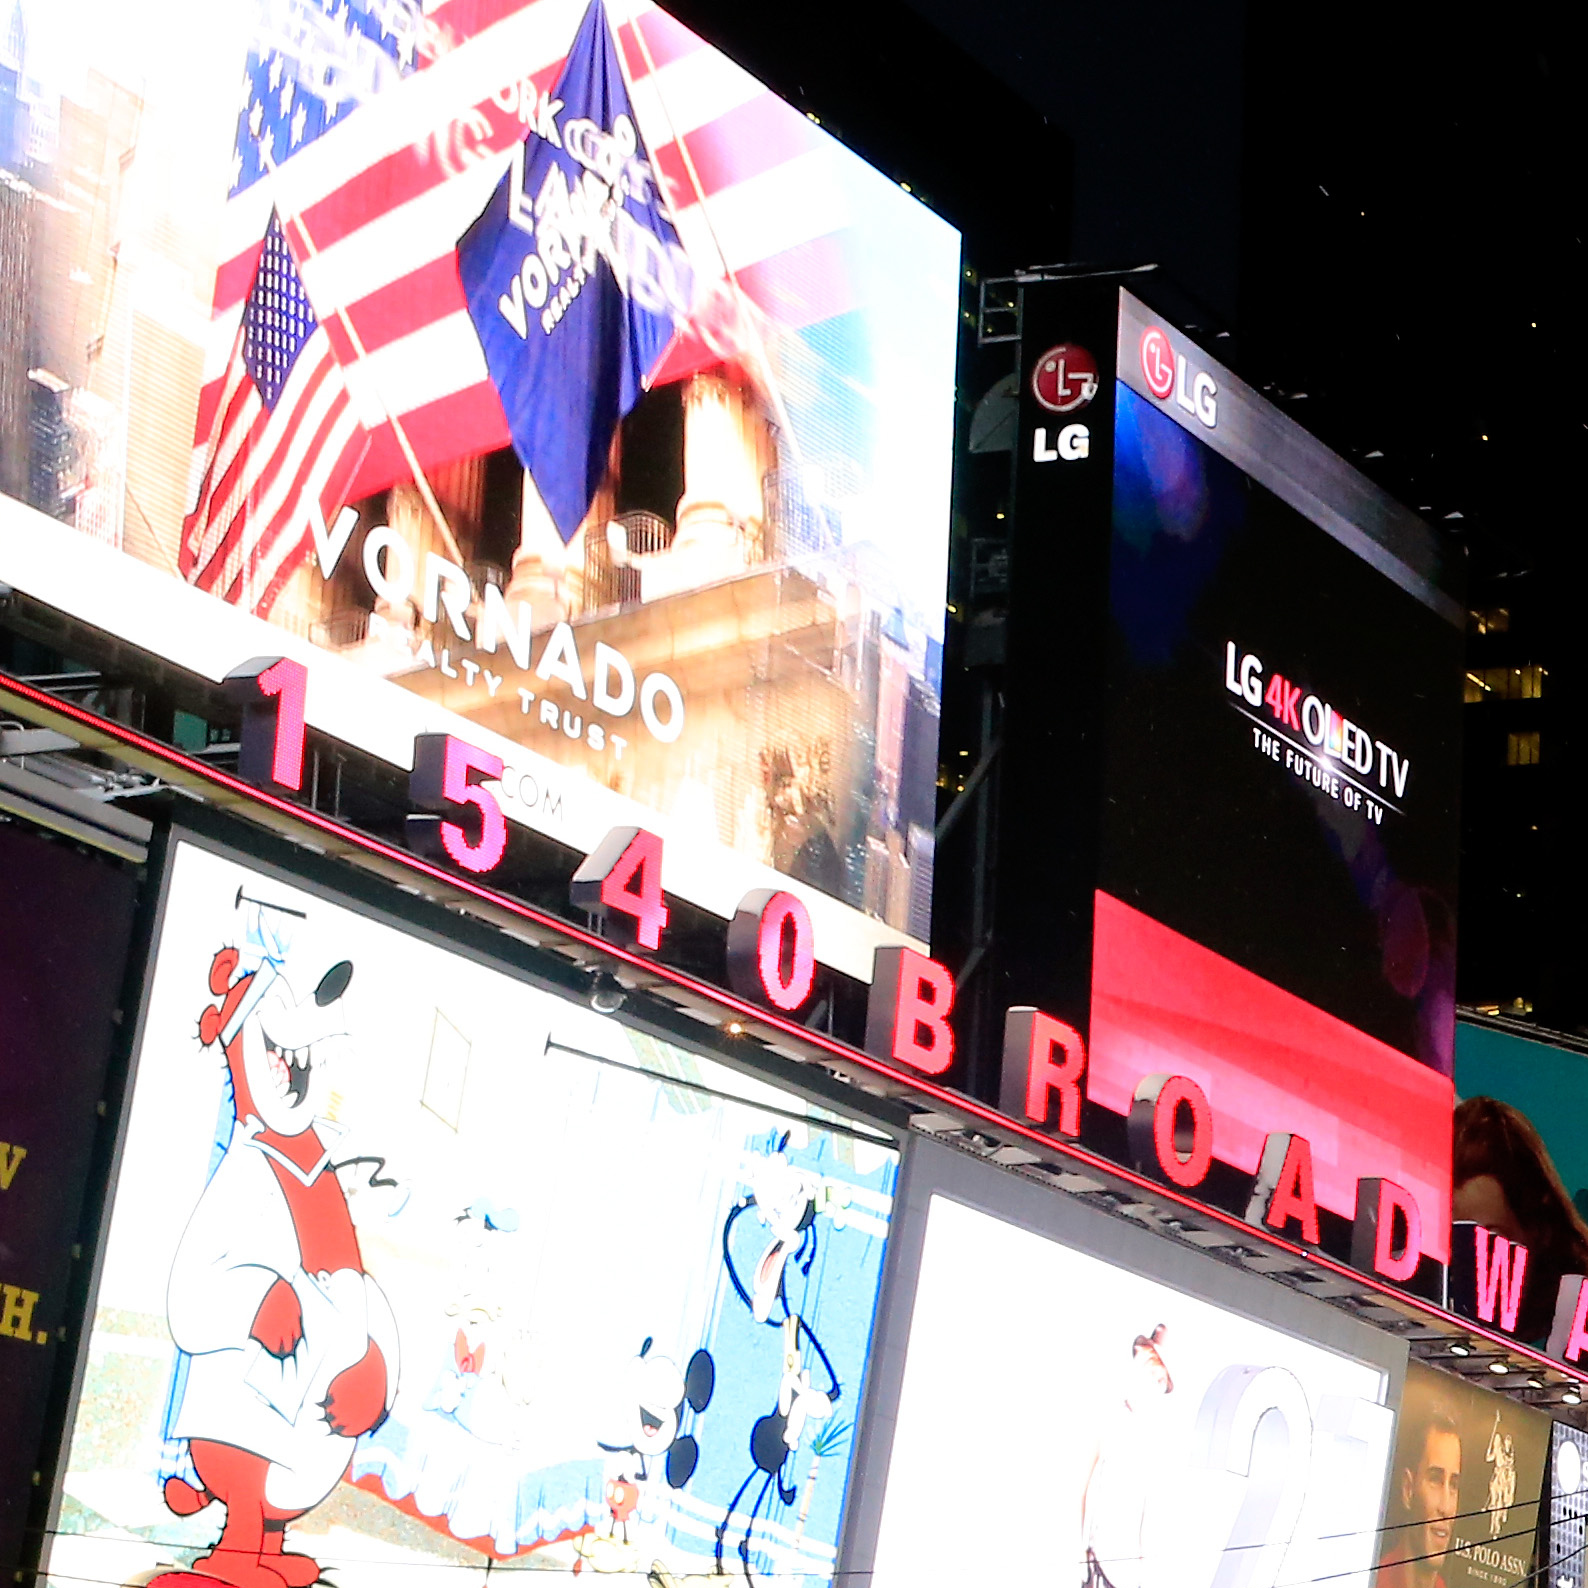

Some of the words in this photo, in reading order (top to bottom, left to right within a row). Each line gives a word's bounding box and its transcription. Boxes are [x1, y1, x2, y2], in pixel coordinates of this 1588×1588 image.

[1175, 353, 1218, 429] LG
[1033, 423, 1090, 463] LG
[307, 504, 685, 744] VORNADO
[517, 688, 629, 761] TRUST
[1225, 640, 1263, 707] LG
[1264, 672, 1302, 732] 4K
[1302, 694, 1376, 776] OLED
[1376, 740, 1410, 799] TV
[1252, 727, 1281, 762] THE
[1286, 751, 1340, 800] FUTURE
[1344, 785, 1362, 811] OF
[1366, 797, 1383, 825] TV
[257, 656, 815, 1012] 1540
[1473, 1545, 1500, 1568] POLO
